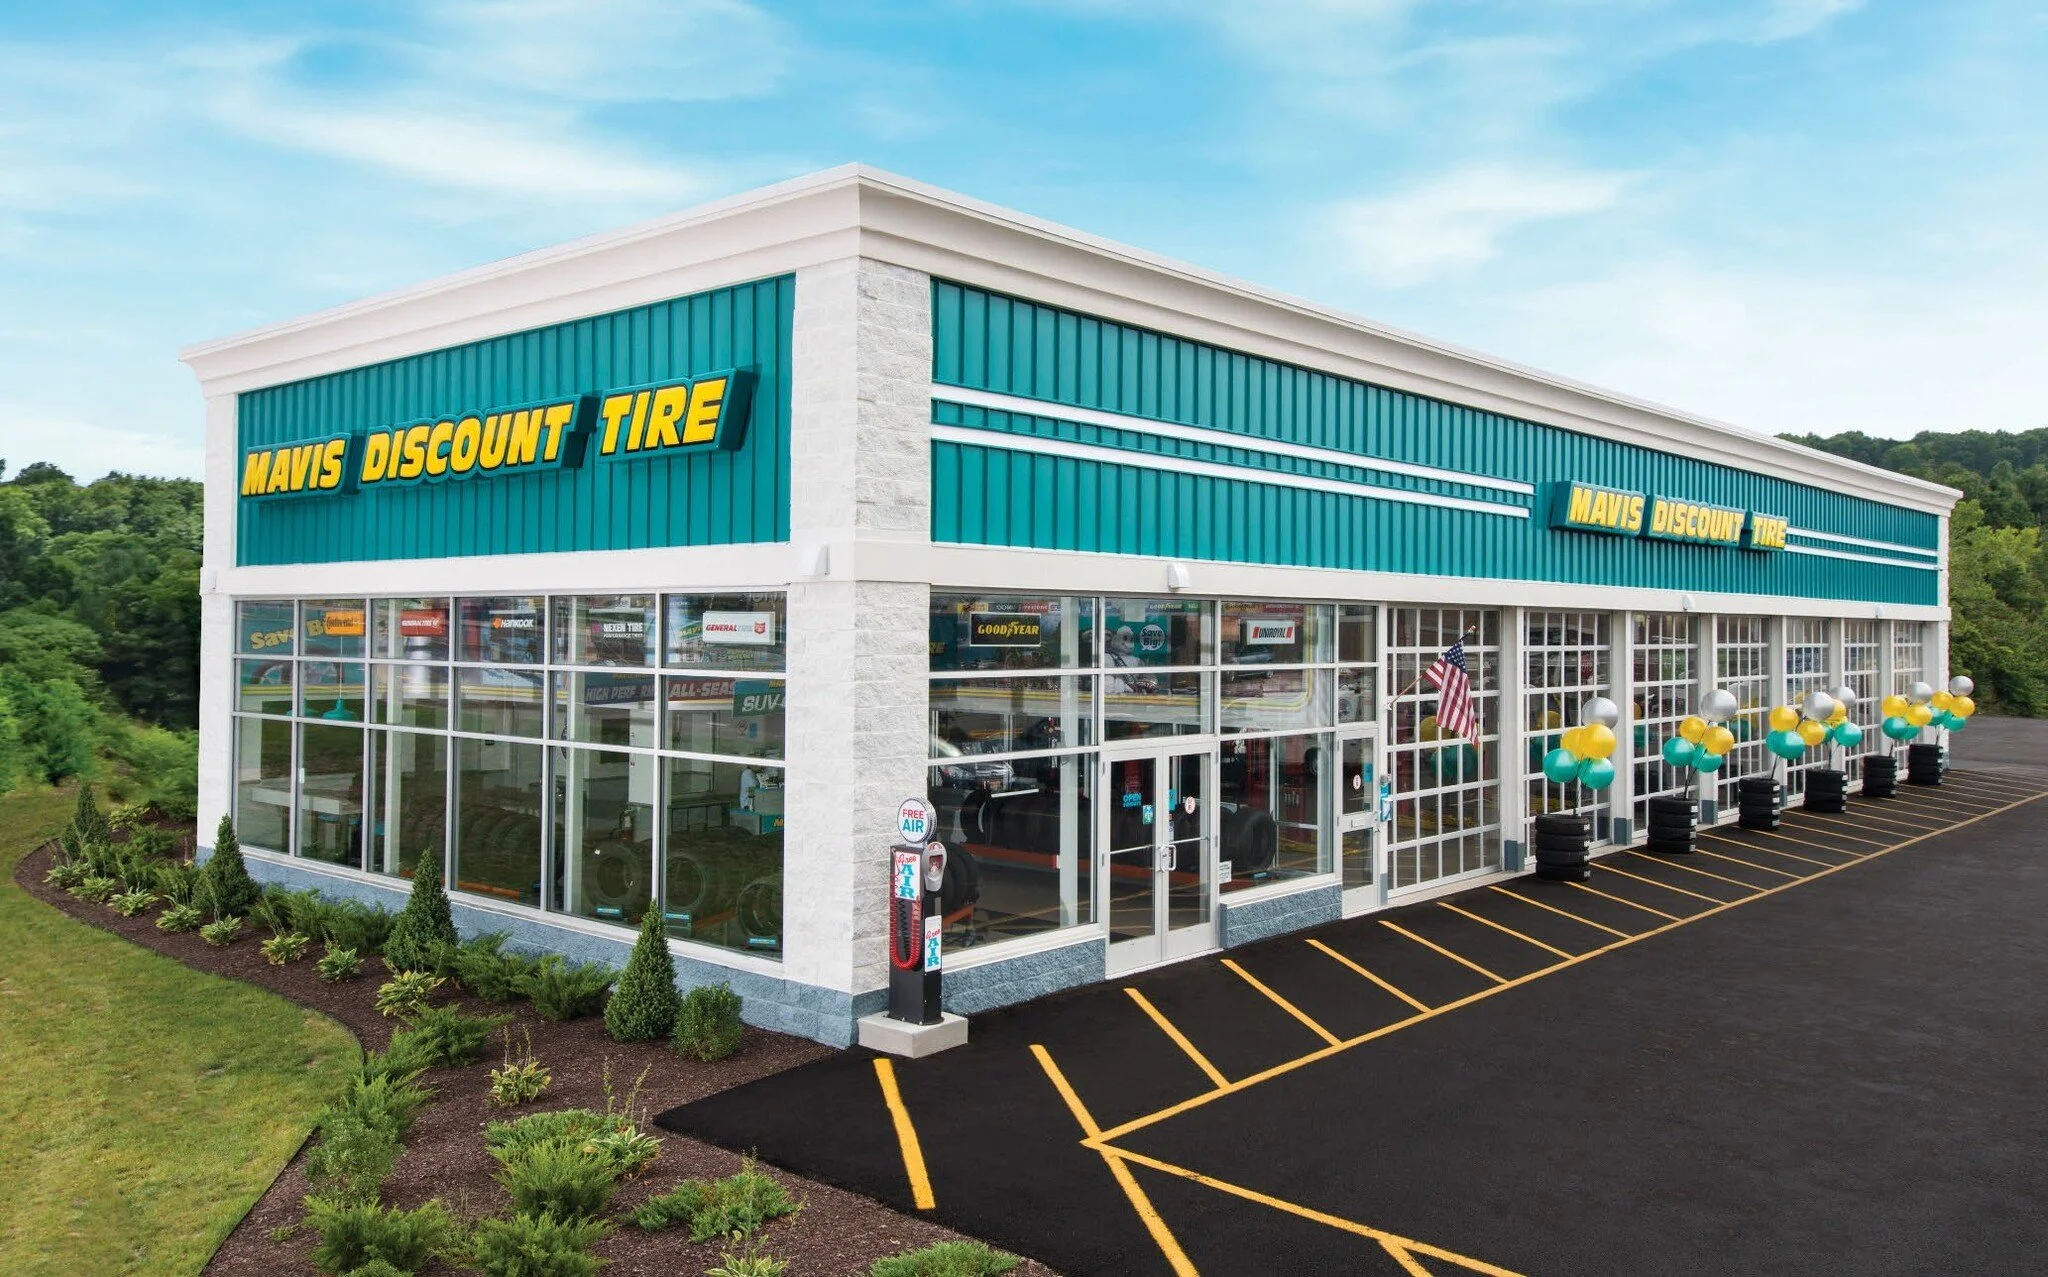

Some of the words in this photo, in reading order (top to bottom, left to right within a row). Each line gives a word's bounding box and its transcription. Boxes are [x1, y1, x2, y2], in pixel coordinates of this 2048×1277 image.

[241, 439, 346, 498] MAVIS
[360, 403, 577, 485] DISCOUNT
[601, 376, 729, 456] TIRE
[1568, 485, 1644, 533] MAVIS
[1651, 499, 1746, 542] DISCOUNT
[1752, 515, 1788, 550] TIRE
[603, 623, 626, 632] NEXEN
[627, 622, 643, 632] TIRE
[706, 624, 738, 633] GENERAL
[977, 621, 1040, 638] GOODYEAR
[1259, 627, 1287, 639] UNIROYAL
[1142, 629, 1163, 638] Save
[1123, 793, 1142, 803] OPEN
[902, 808, 925, 820] FREE
[902, 818, 925, 833] AIR
